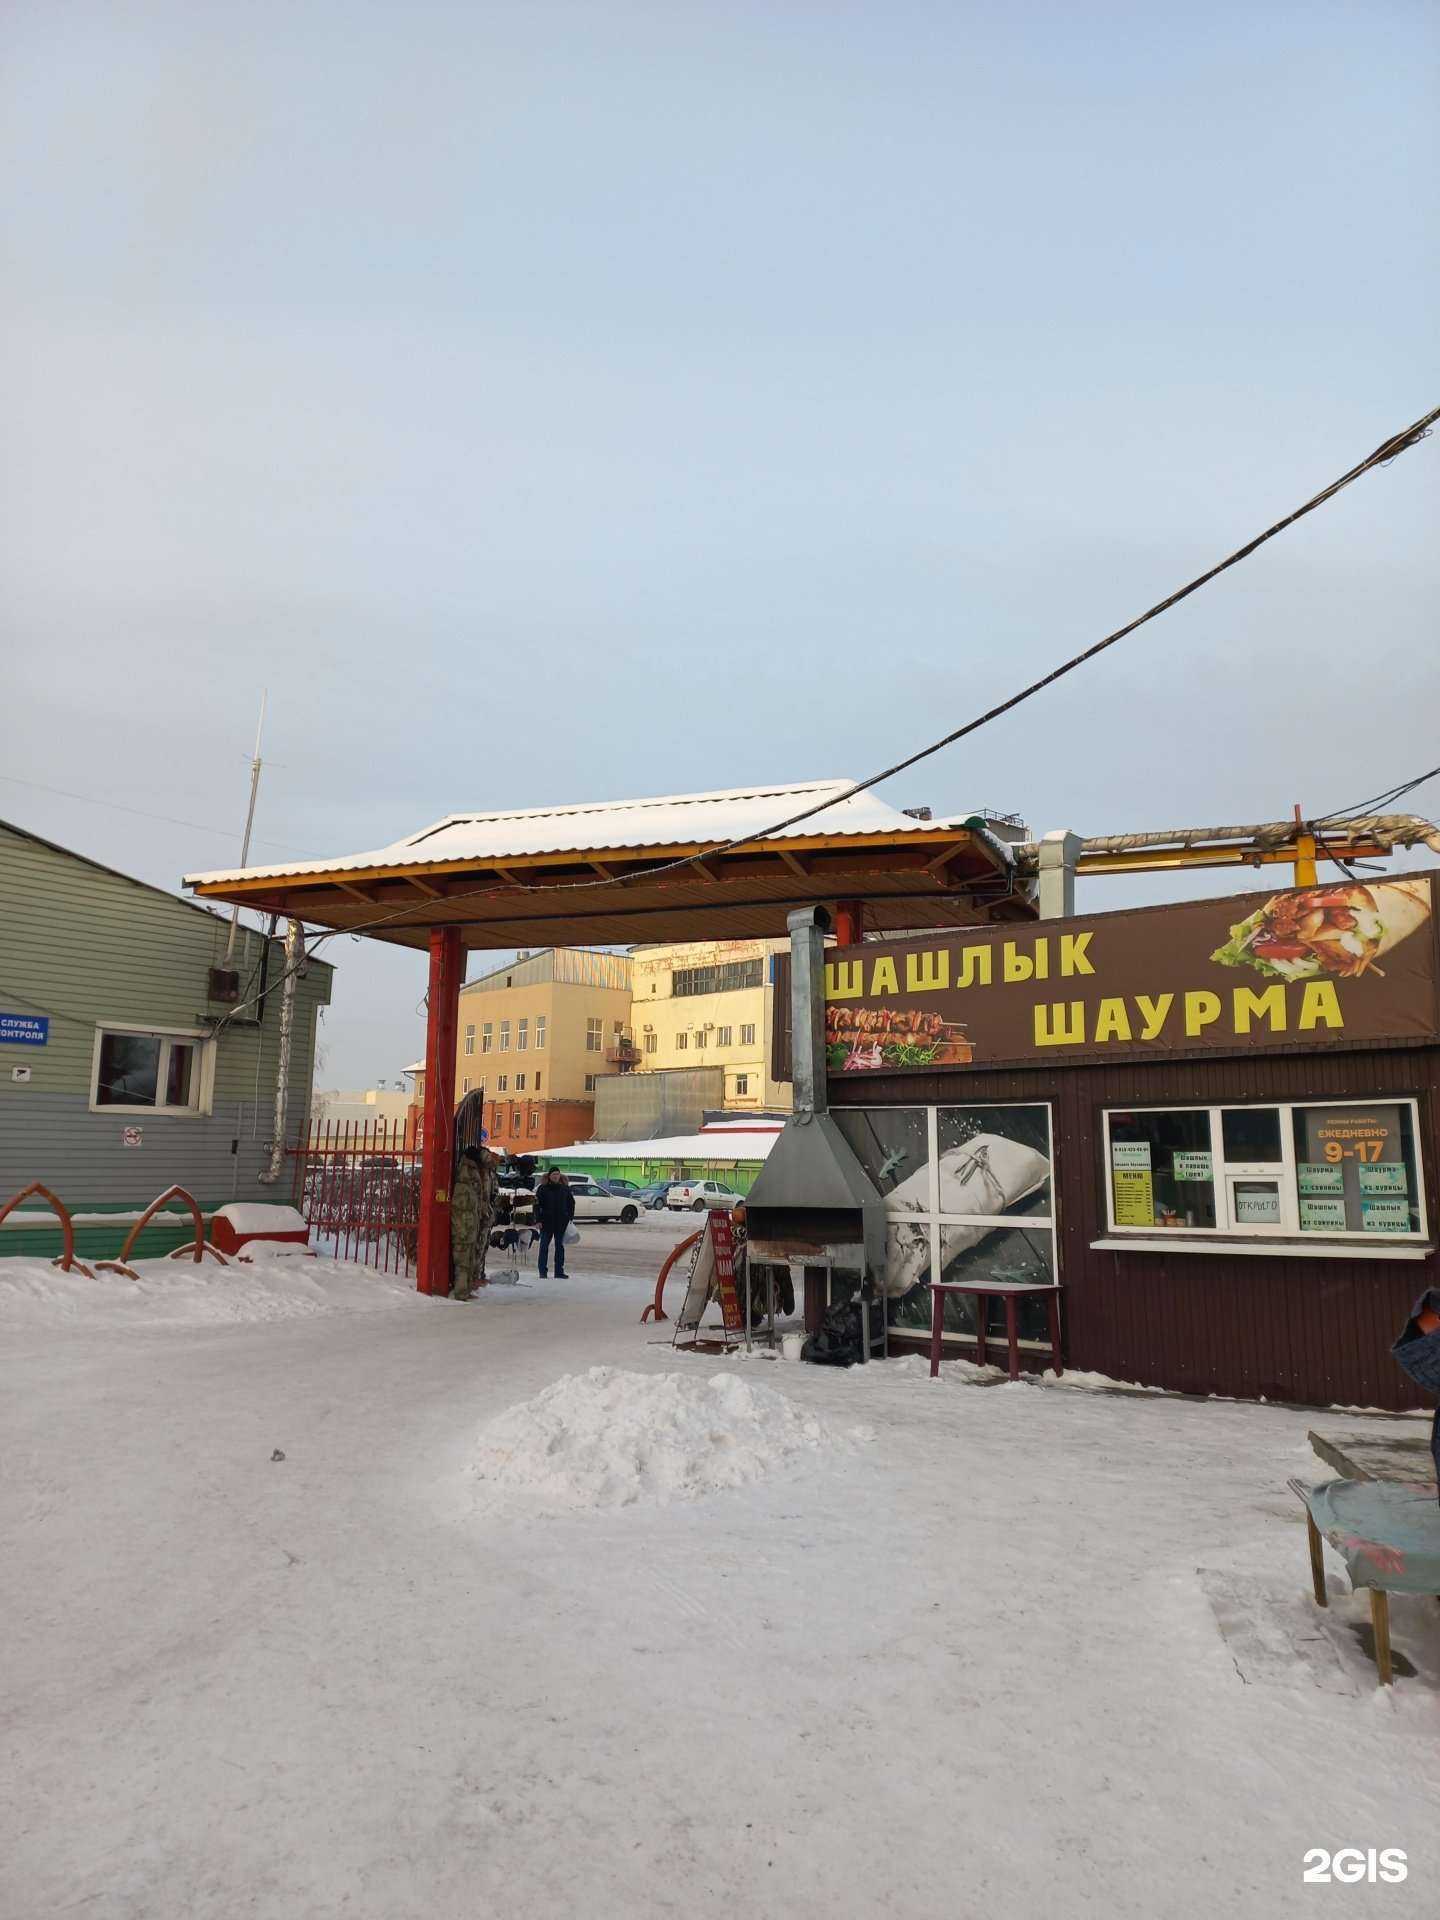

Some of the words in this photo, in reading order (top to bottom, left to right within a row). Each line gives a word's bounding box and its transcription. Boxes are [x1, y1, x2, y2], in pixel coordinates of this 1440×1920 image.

[825, 931, 1097, 1000] ШАШЛЫК
[1034, 980, 1345, 1048] ШАУРМА
[0, 1019, 40, 1030] СЛУЖБА
[0, 1028, 44, 1040] ОНТРОЛЯ
[1318, 1128, 1389, 1138] ЕЖЕДНЕВНО
[1324, 1140, 1385, 1163] 9-17
[1238, 1200, 1278, 1211] ОТКРЫТО
